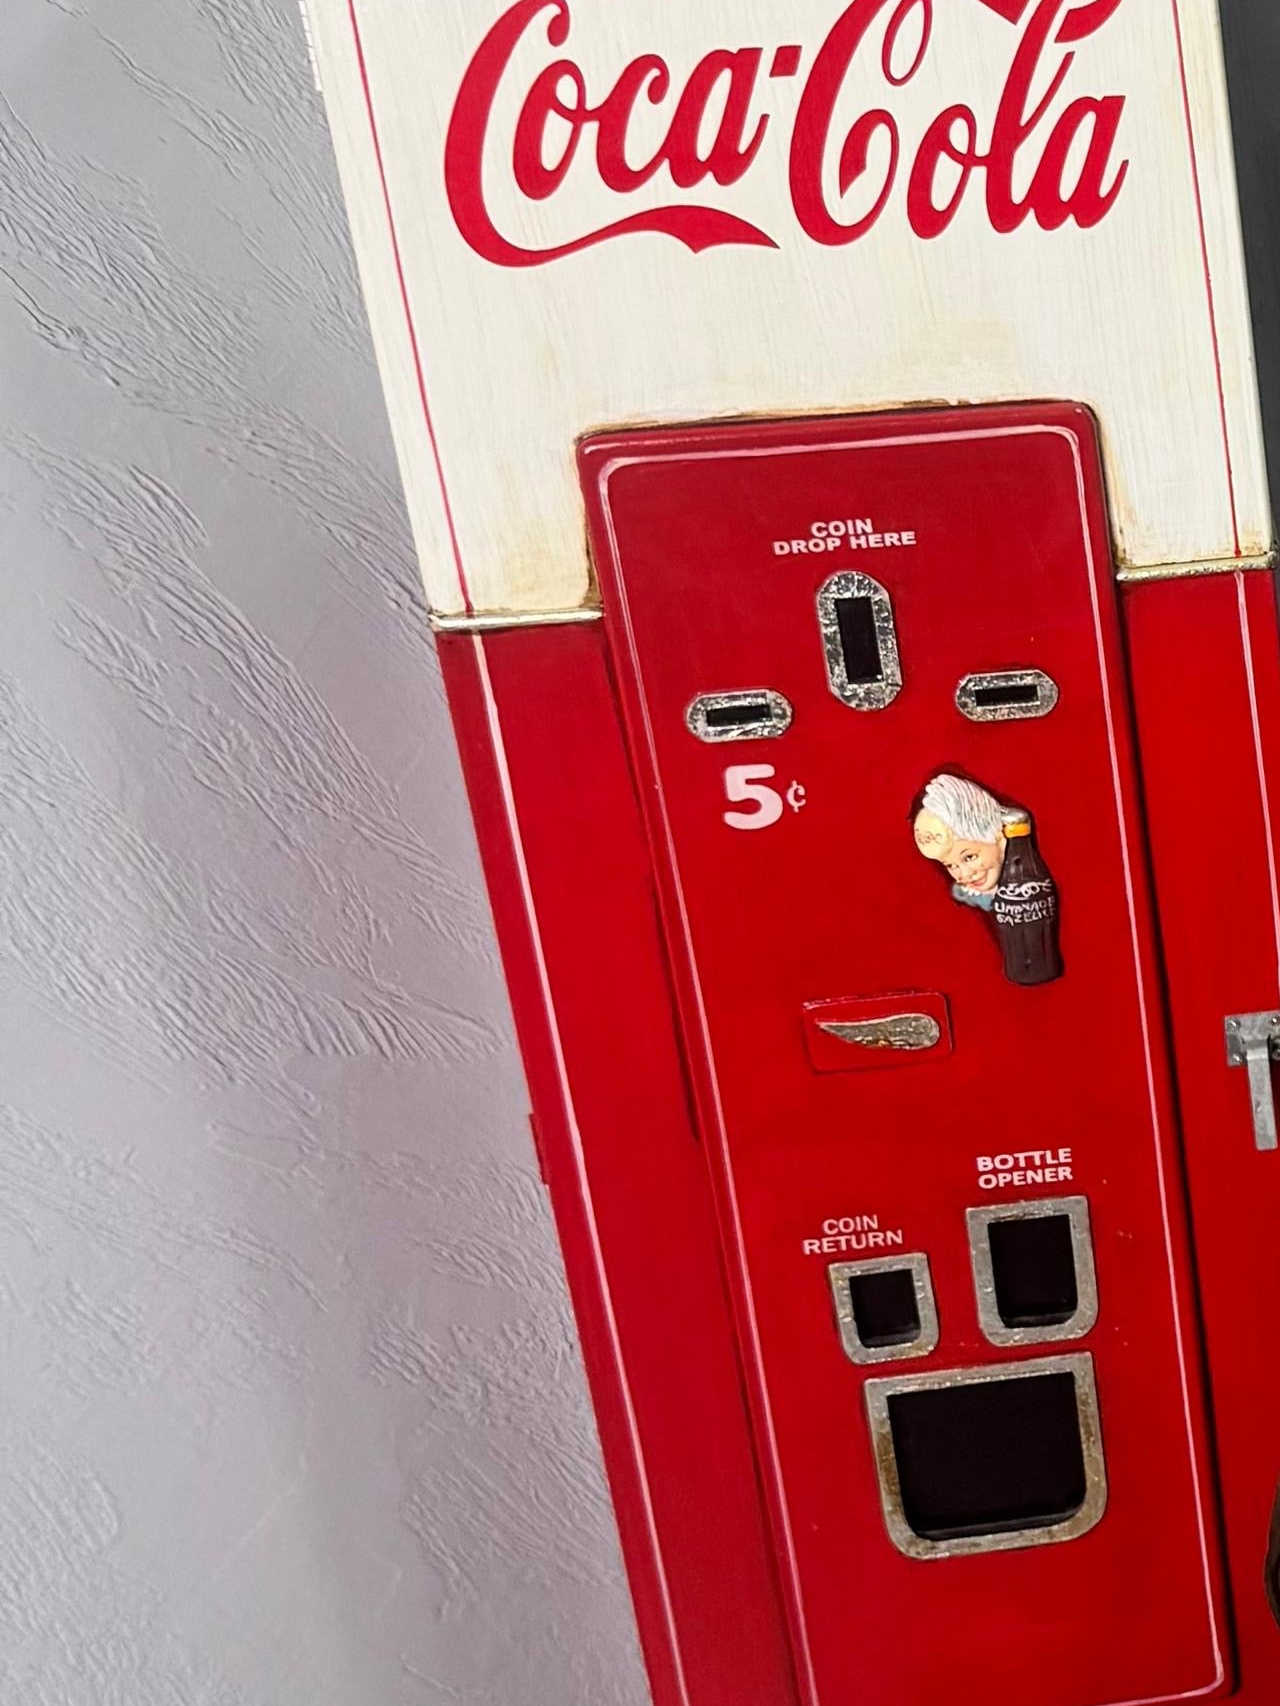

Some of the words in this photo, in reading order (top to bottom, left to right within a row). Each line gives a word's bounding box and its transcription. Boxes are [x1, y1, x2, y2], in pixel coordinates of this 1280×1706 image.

[810, 518, 873, 539] COIN
[773, 537, 844, 556] DROP
[849, 530, 917, 549] HERE
[976, 1148, 1073, 1173] BOTTLE
[978, 1166, 1074, 1189] OPENER
[822, 1215, 879, 1236] COIN
[802, 1228, 904, 1256] RETURN
